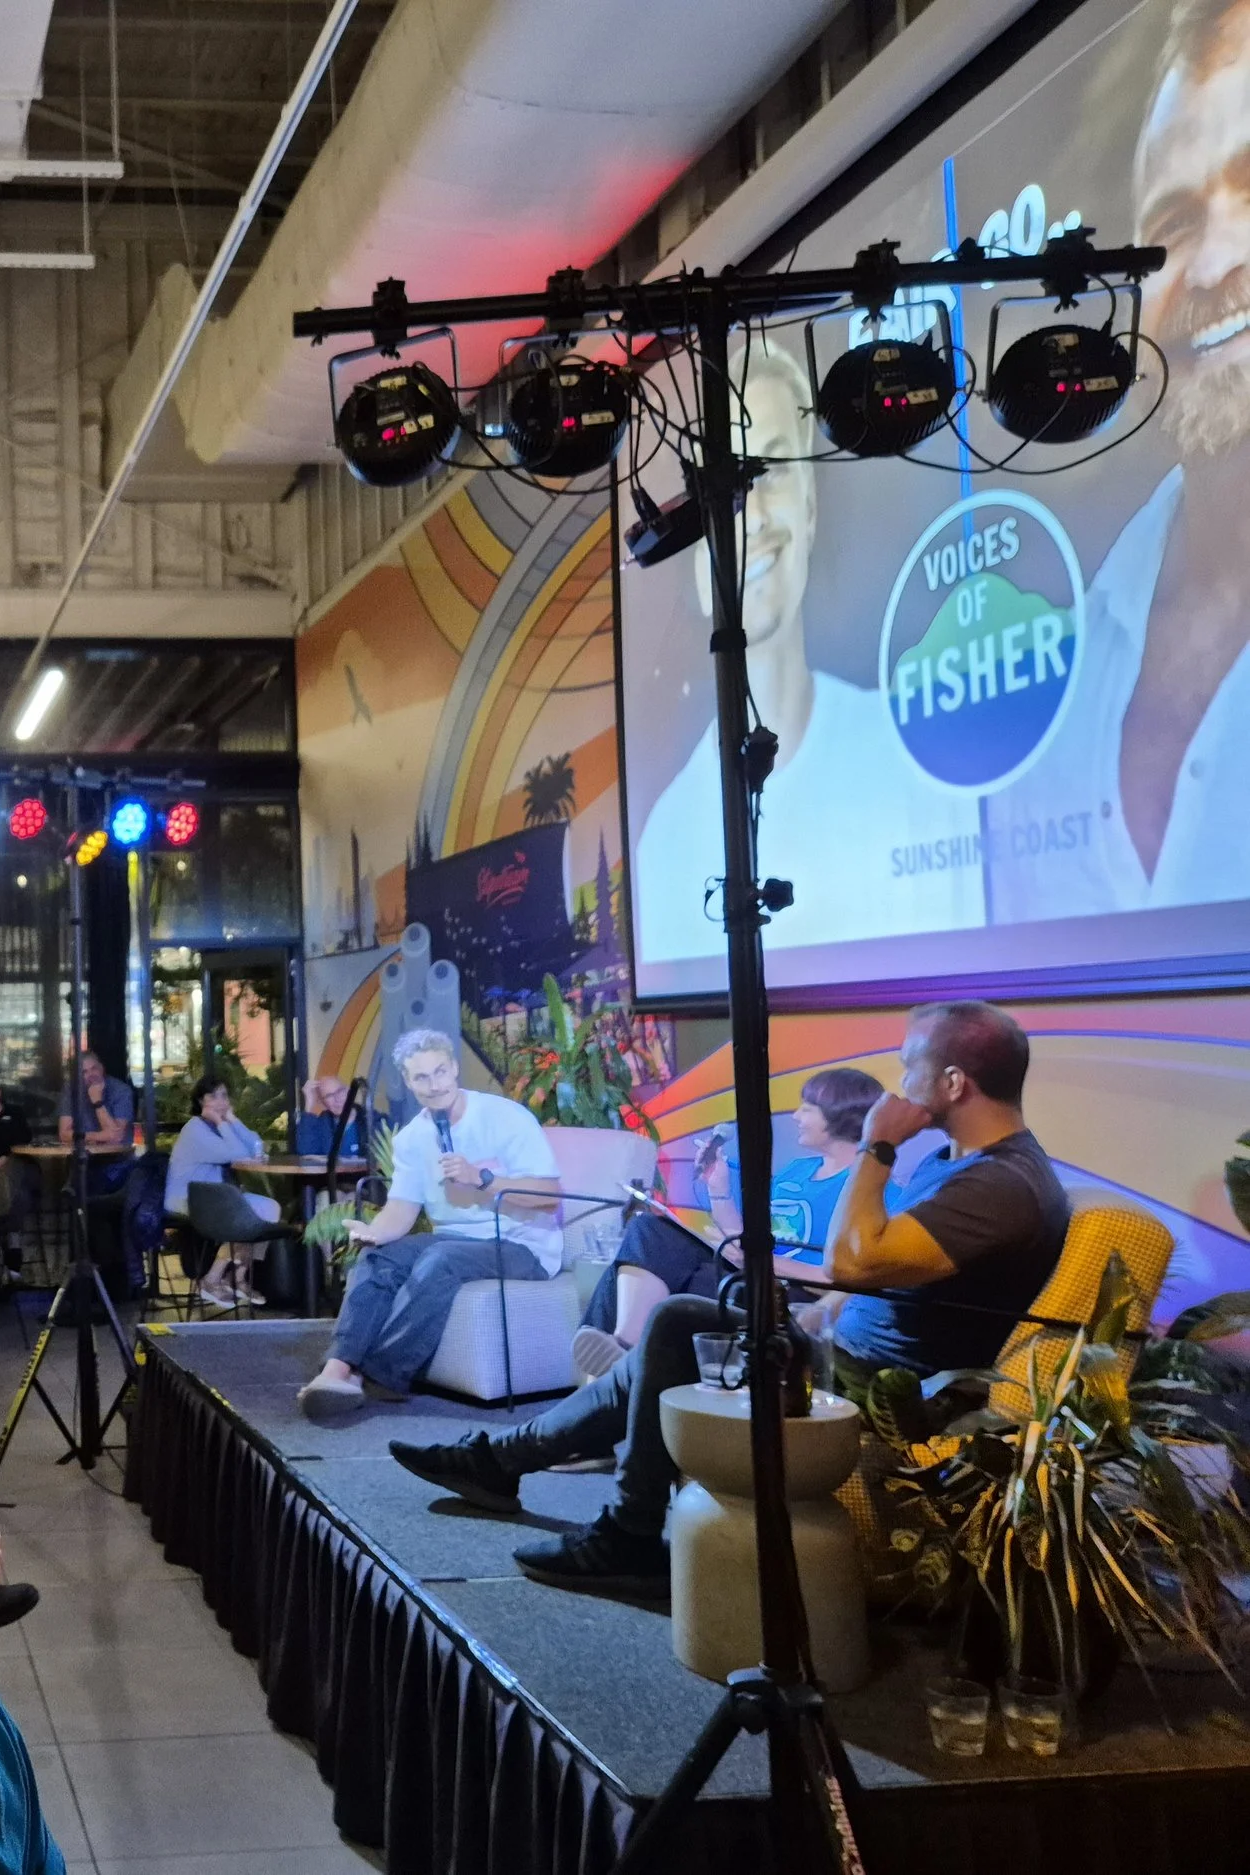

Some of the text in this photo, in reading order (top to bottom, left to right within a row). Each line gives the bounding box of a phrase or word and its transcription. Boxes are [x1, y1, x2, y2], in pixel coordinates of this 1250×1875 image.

[923, 516, 1020, 591] VOICES
[956, 580, 988, 627] OF
[896, 613, 1067, 726] FISHER
[1011, 811, 1093, 859] COAST
